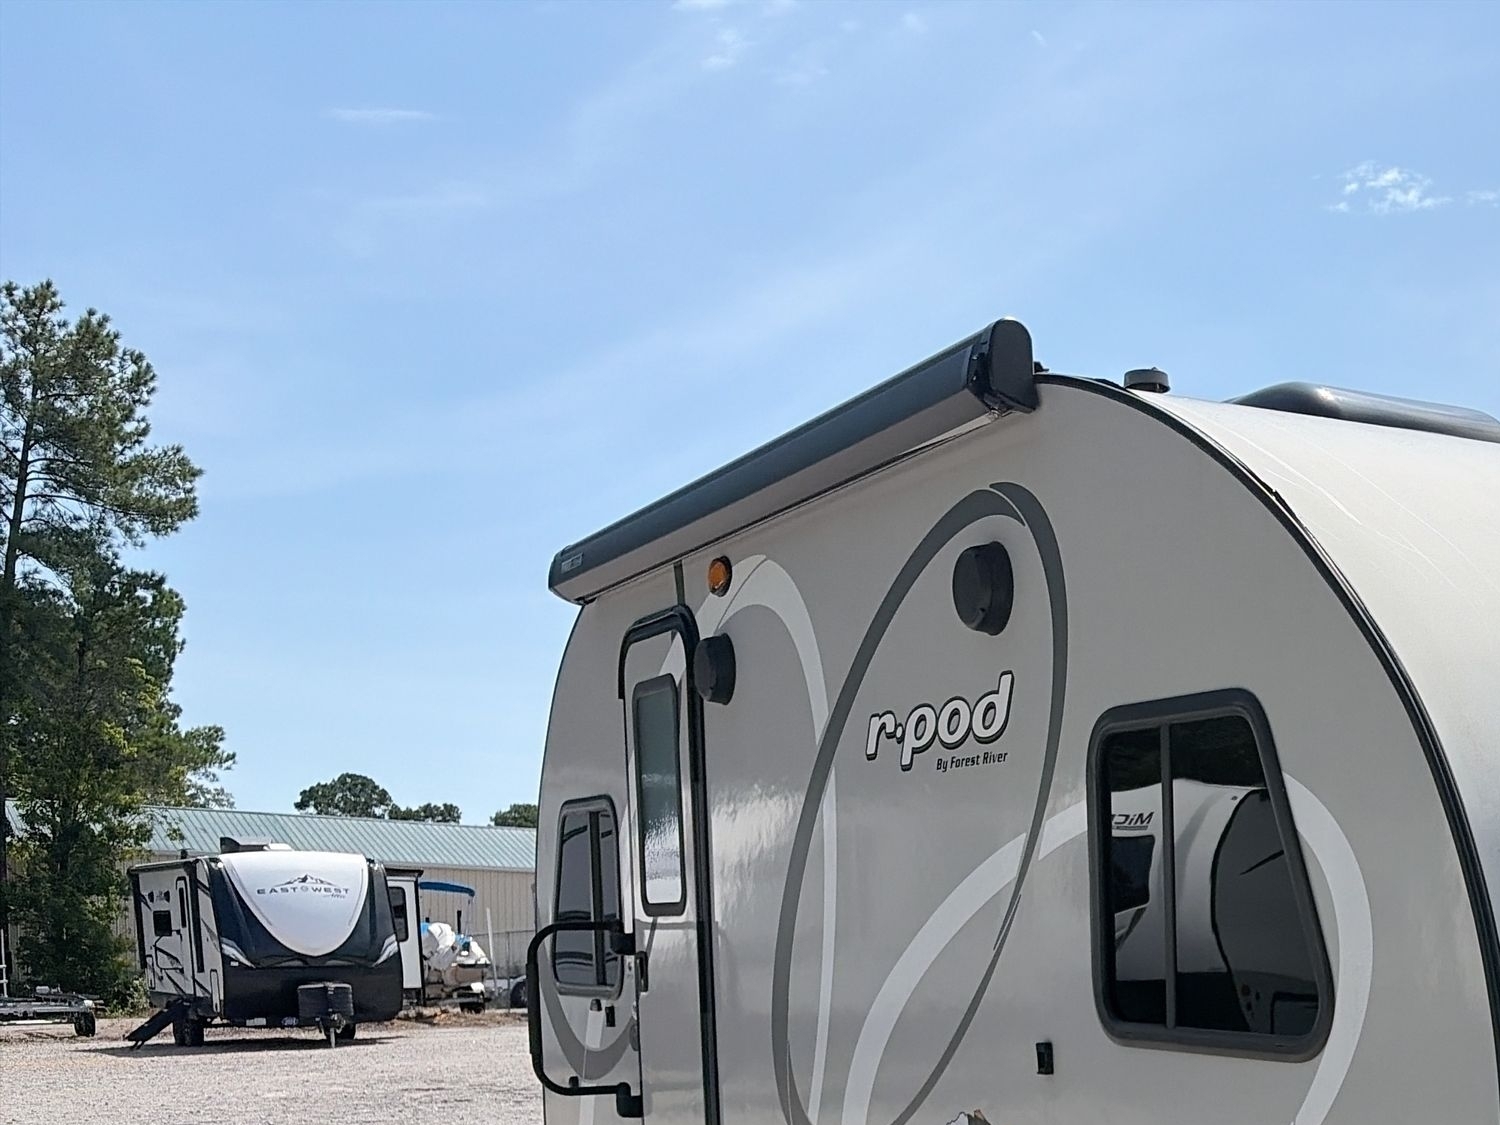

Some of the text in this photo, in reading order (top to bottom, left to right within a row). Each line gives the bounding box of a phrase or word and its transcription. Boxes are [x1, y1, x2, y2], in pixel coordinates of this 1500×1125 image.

[936, 750, 1008, 772] By Forest River
[257, 887, 350, 895] EAST WEST
